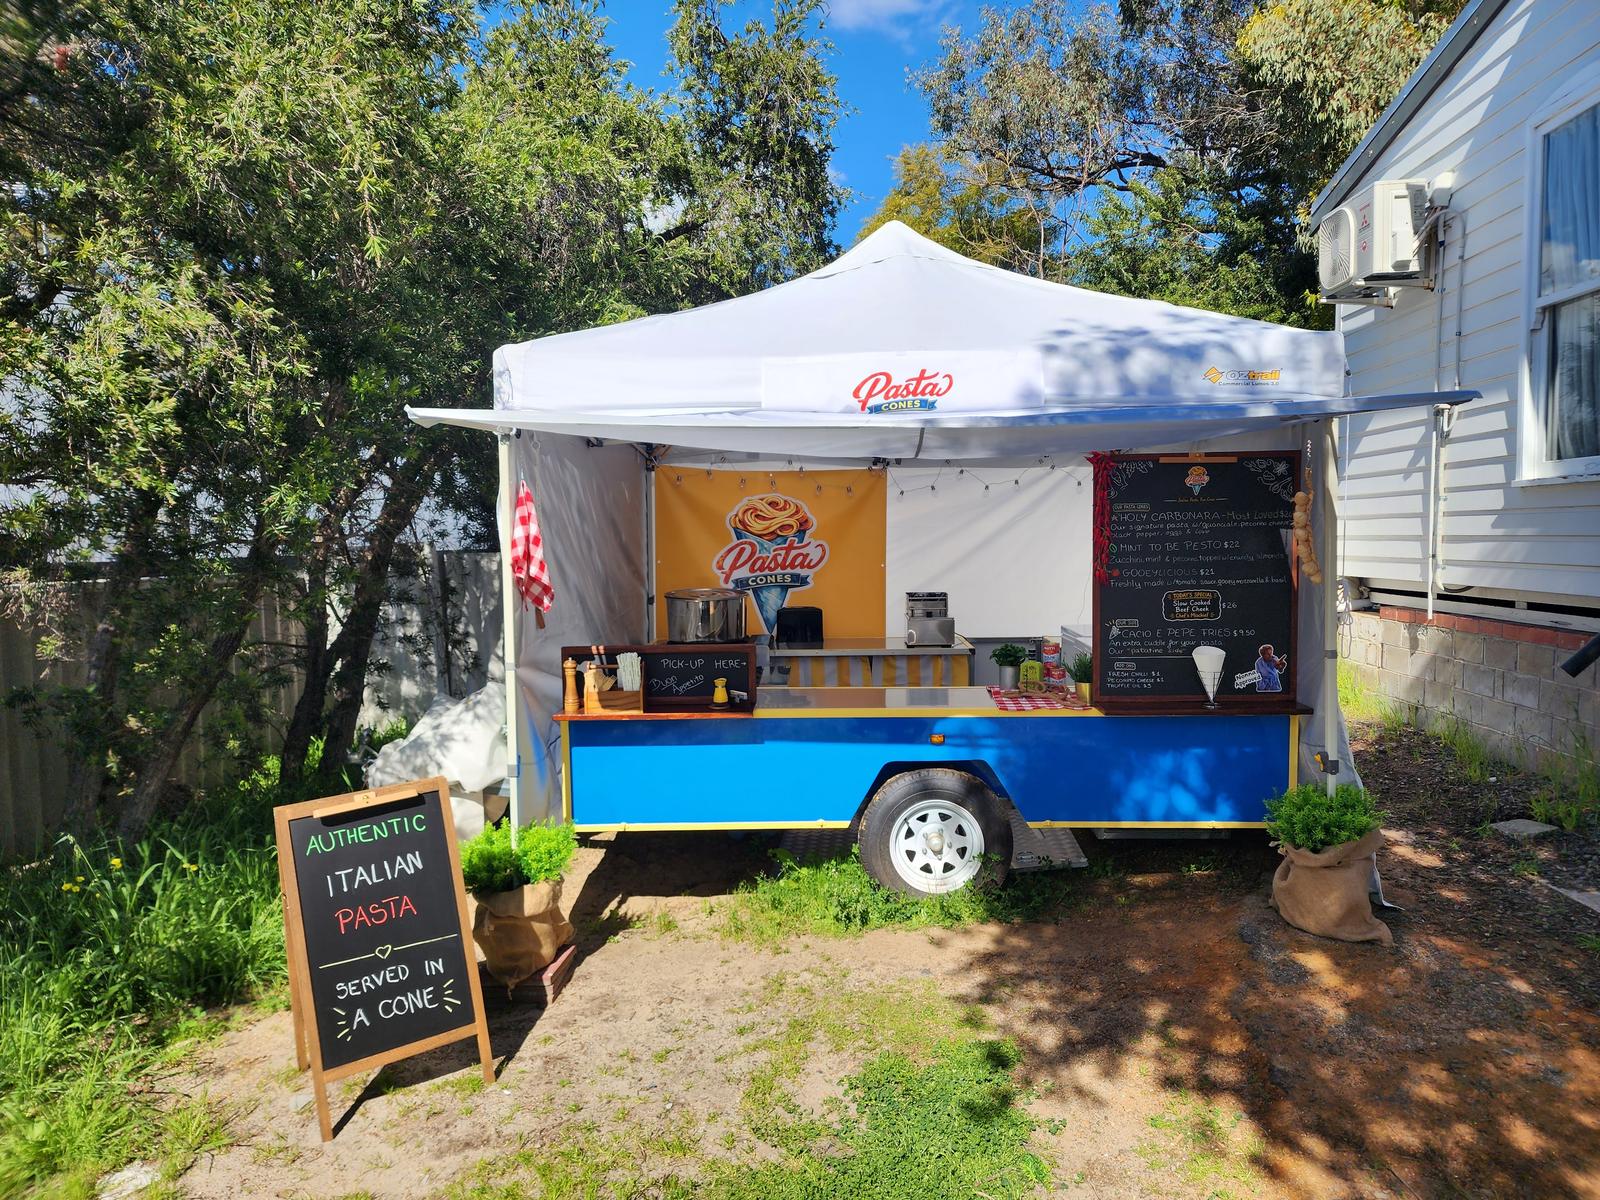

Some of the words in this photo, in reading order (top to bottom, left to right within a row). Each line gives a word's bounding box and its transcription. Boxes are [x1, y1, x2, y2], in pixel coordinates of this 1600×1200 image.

[853, 368, 953, 411] Pasta
[881, 400, 921, 411] CONES
[1120, 512, 1147, 522] HOLY
[1151, 511, 1221, 521] CARBONARA
[1120, 543, 1141, 552] MINT
[1149, 543, 1161, 551] TO
[1165, 542, 1179, 551] BE
[1184, 540, 1222, 551] PESTO
[1223, 540, 1240, 549] $22
[716, 538, 826, 584] Pasta
[1199, 568, 1215, 576] $21
[748, 574, 791, 586] CONES
[1110, 578, 1142, 590] Freshly
[1144, 578, 1164, 588] made
[1122, 630, 1152, 638] CACIO
[1156, 629, 1162, 638] E
[1167, 627, 1196, 637] PEPE
[1167, 639, 1178, 649] for
[1180, 639, 1196, 648] your
[1109, 647, 1124, 655] Our
[660, 658, 705, 669] PICK-UP
[714, 659, 741, 669] HERE
[649, 675, 678, 690] Buon
[672, 674, 705, 695] Appetito
[306, 814, 427, 856] AUTHENTIC
[326, 851, 424, 898] ITALIAN
[334, 895, 418, 936] PASTA
[335, 964, 409, 1000] SERVED
[424, 957, 445, 977] IN
[352, 1007, 371, 1030] A
[378, 986, 440, 1020] CONE
